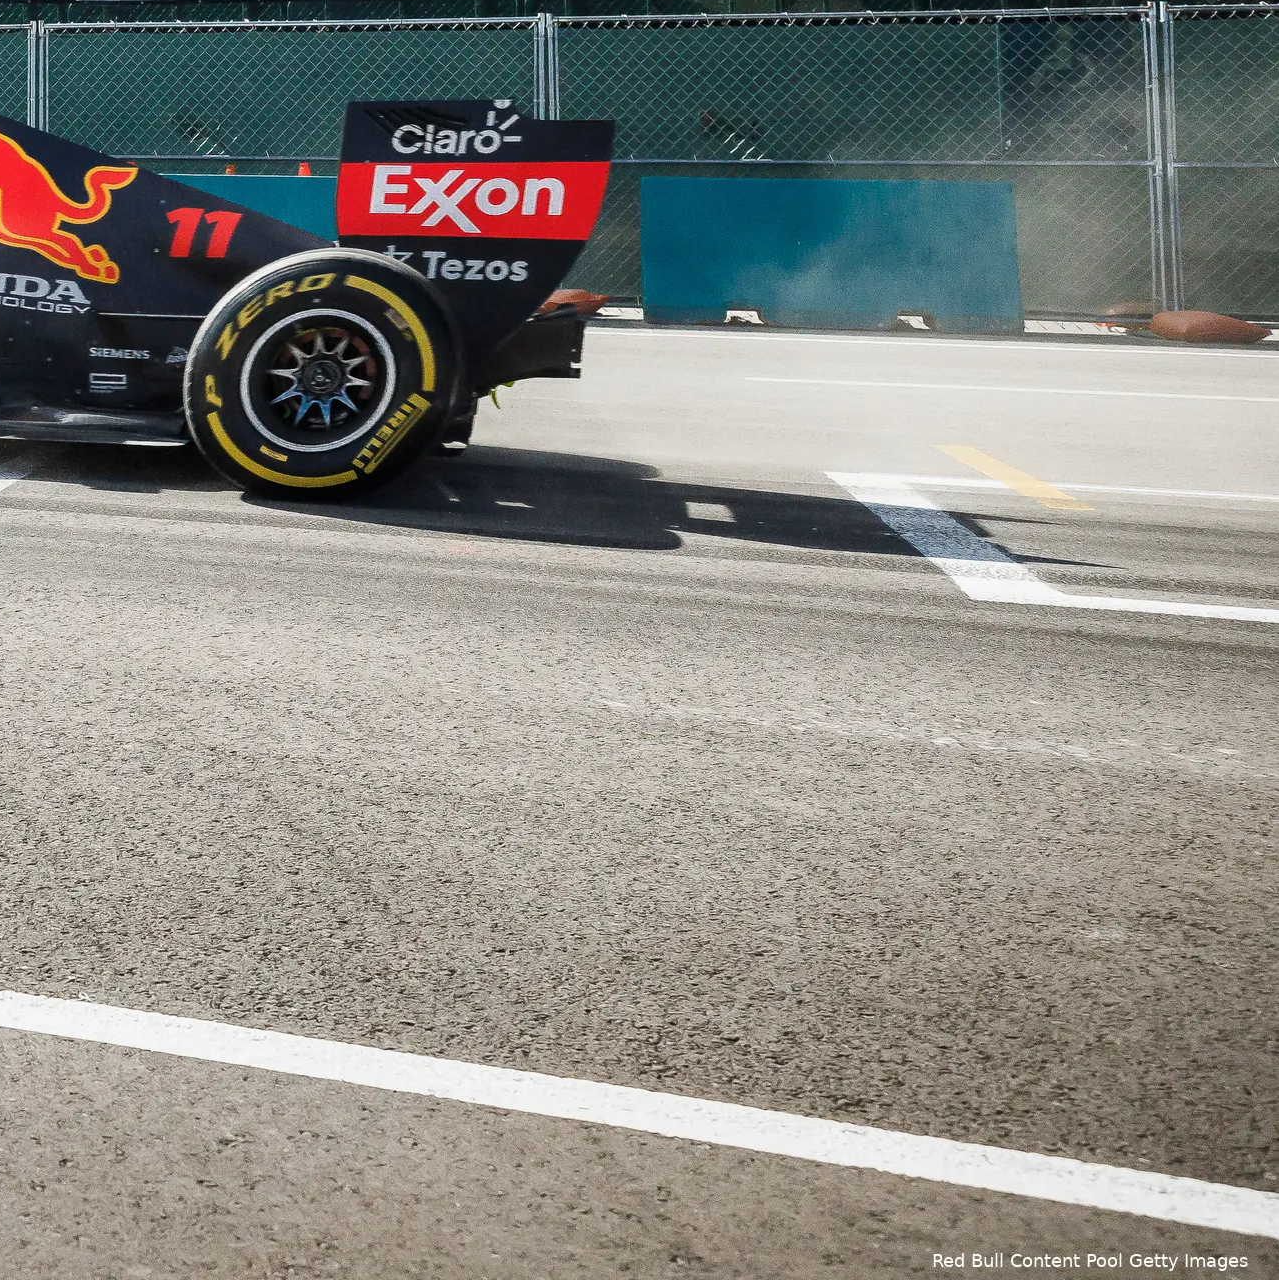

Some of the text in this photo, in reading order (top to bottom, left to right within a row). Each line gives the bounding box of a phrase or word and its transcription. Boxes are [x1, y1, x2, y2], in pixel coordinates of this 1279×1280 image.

[391, 123, 502, 156] Claro
[369, 164, 566, 234] Exxon
[166, 207, 243, 258] 11
[422, 250, 529, 282] Tezos
[214, 273, 337, 361] ZERO
[88, 347, 151, 360] SIEMENS
[351, 392, 432, 475] PIRELLI
